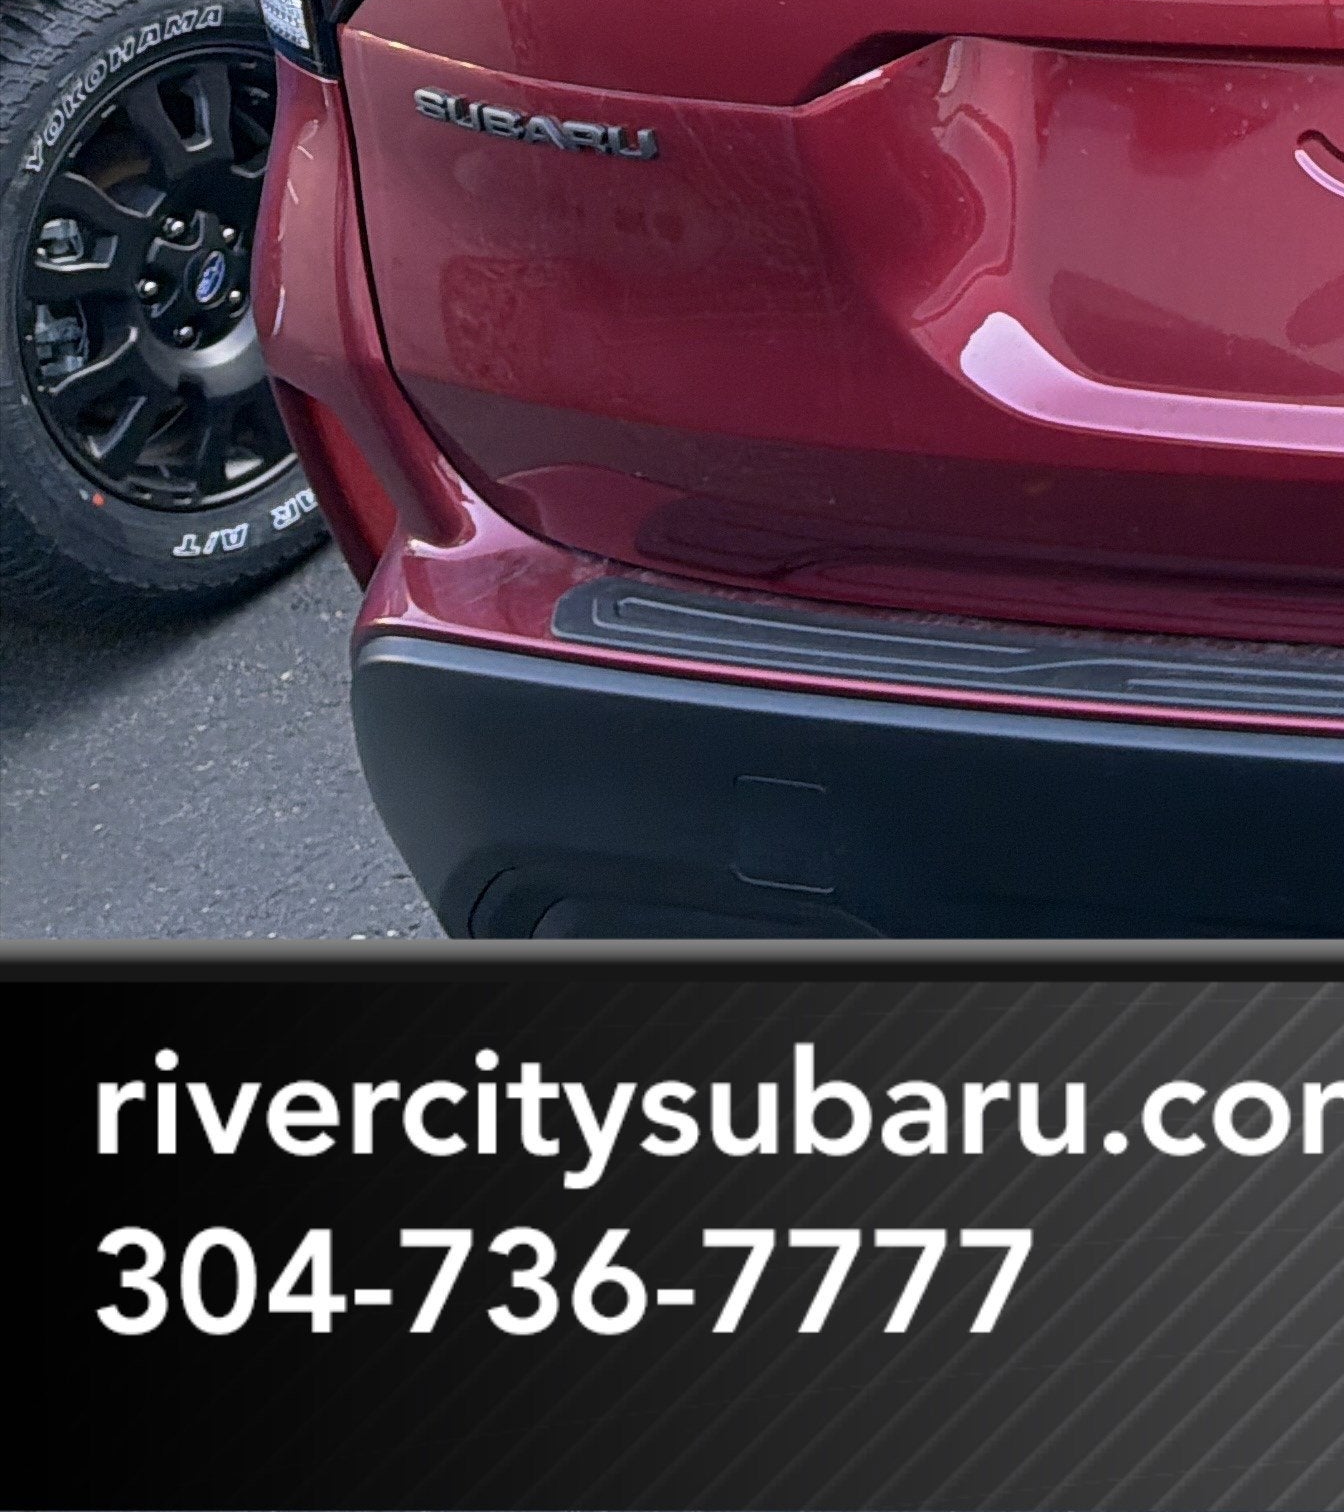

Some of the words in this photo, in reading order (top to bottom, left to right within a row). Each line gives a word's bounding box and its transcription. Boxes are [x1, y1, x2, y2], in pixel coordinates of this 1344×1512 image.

[23, 4, 223, 173] YOKOHAMA
[413, 86, 659, 161] SUBARU
[172, 522, 249, 557] A/T
